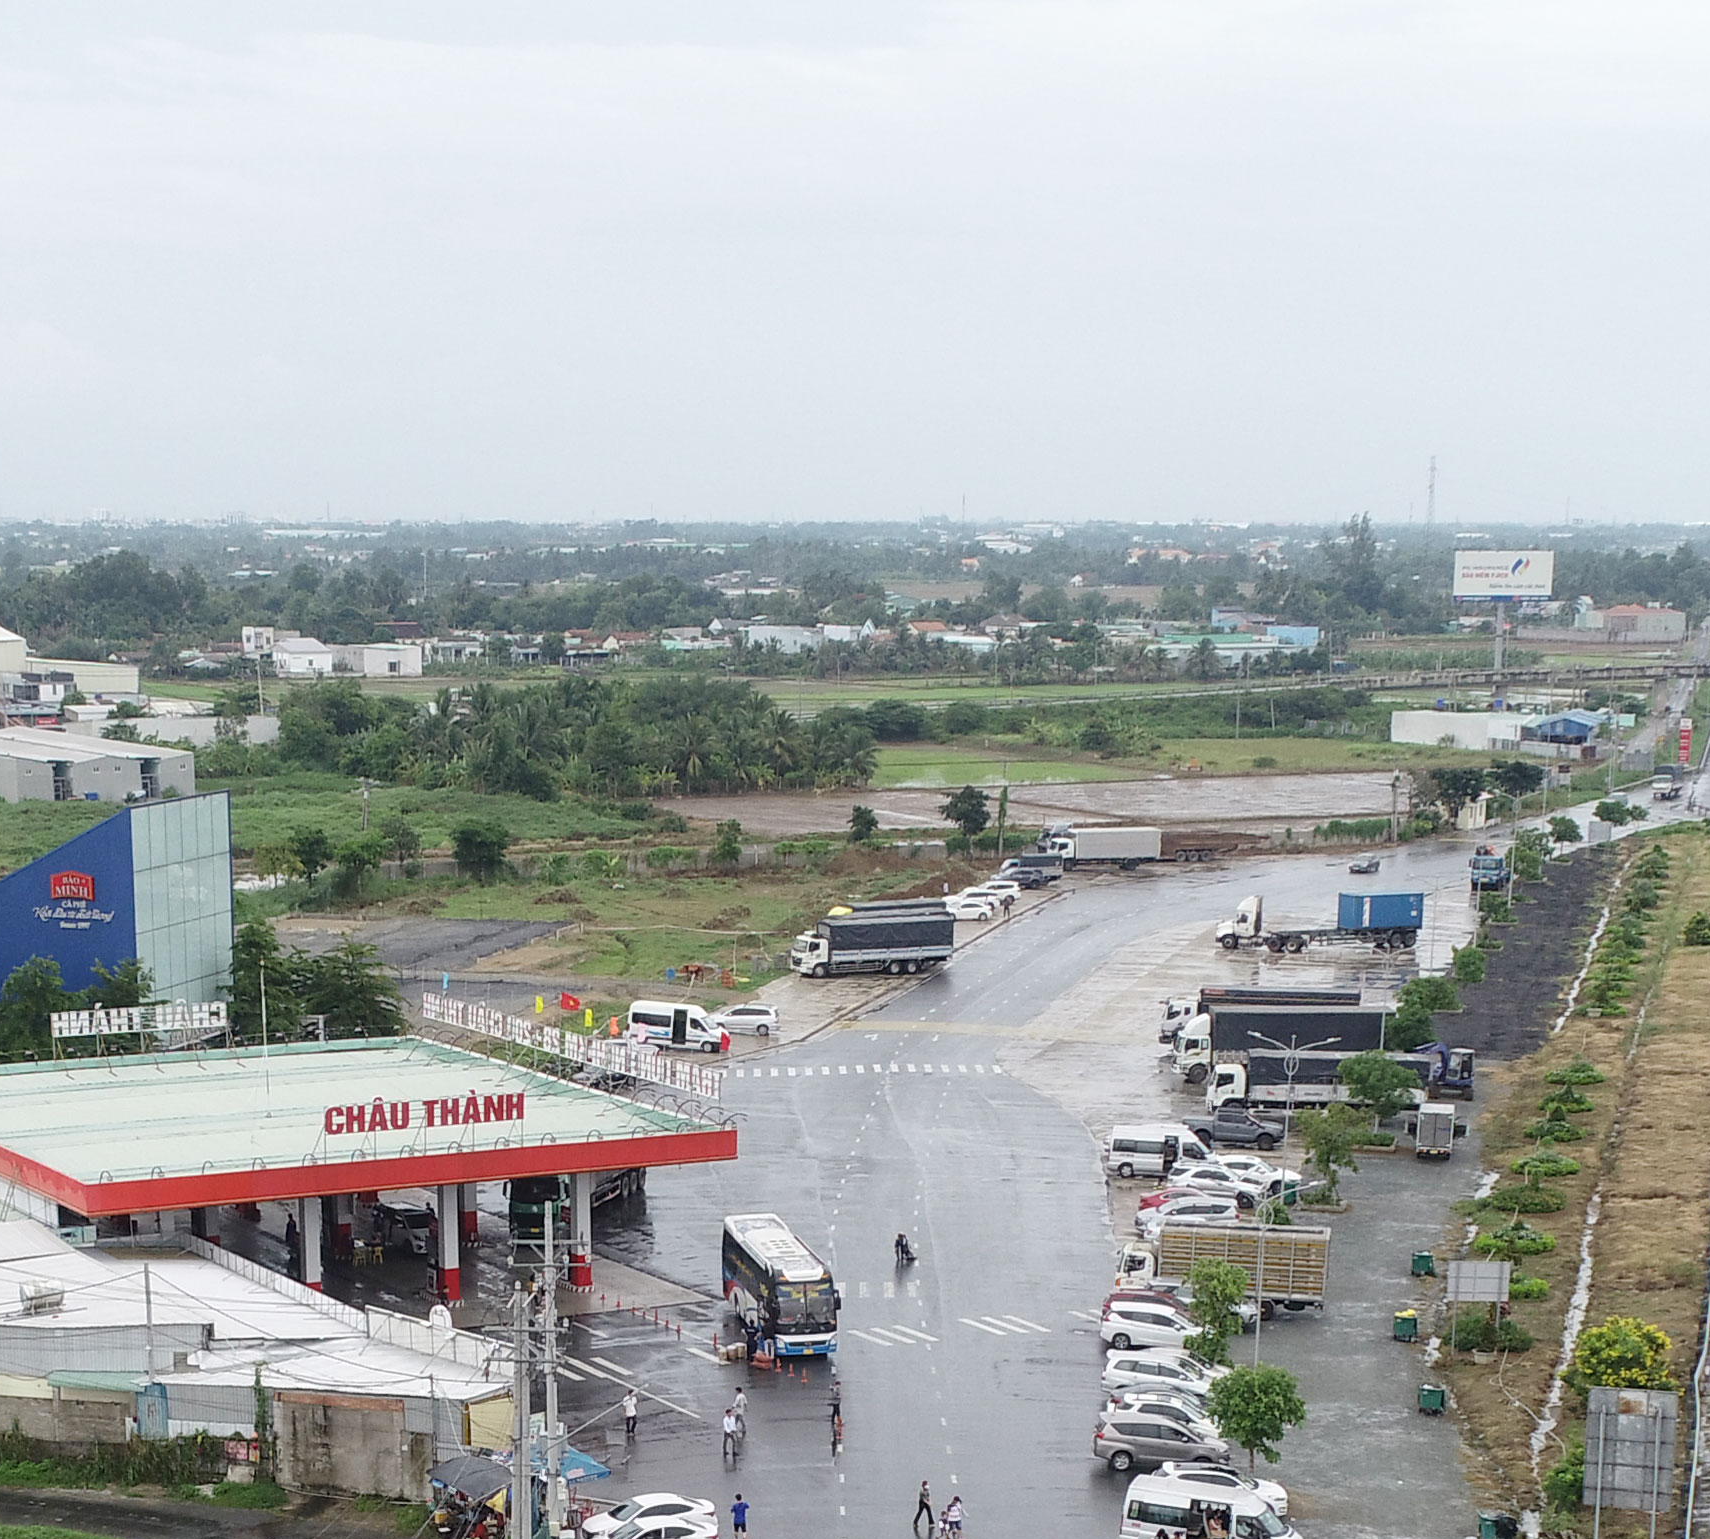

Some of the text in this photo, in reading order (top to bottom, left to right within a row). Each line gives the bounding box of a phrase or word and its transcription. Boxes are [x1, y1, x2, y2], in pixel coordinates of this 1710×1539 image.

[54, 885, 89, 897] MINH
[324, 1089, 525, 1135] CHÂU THÀNH
